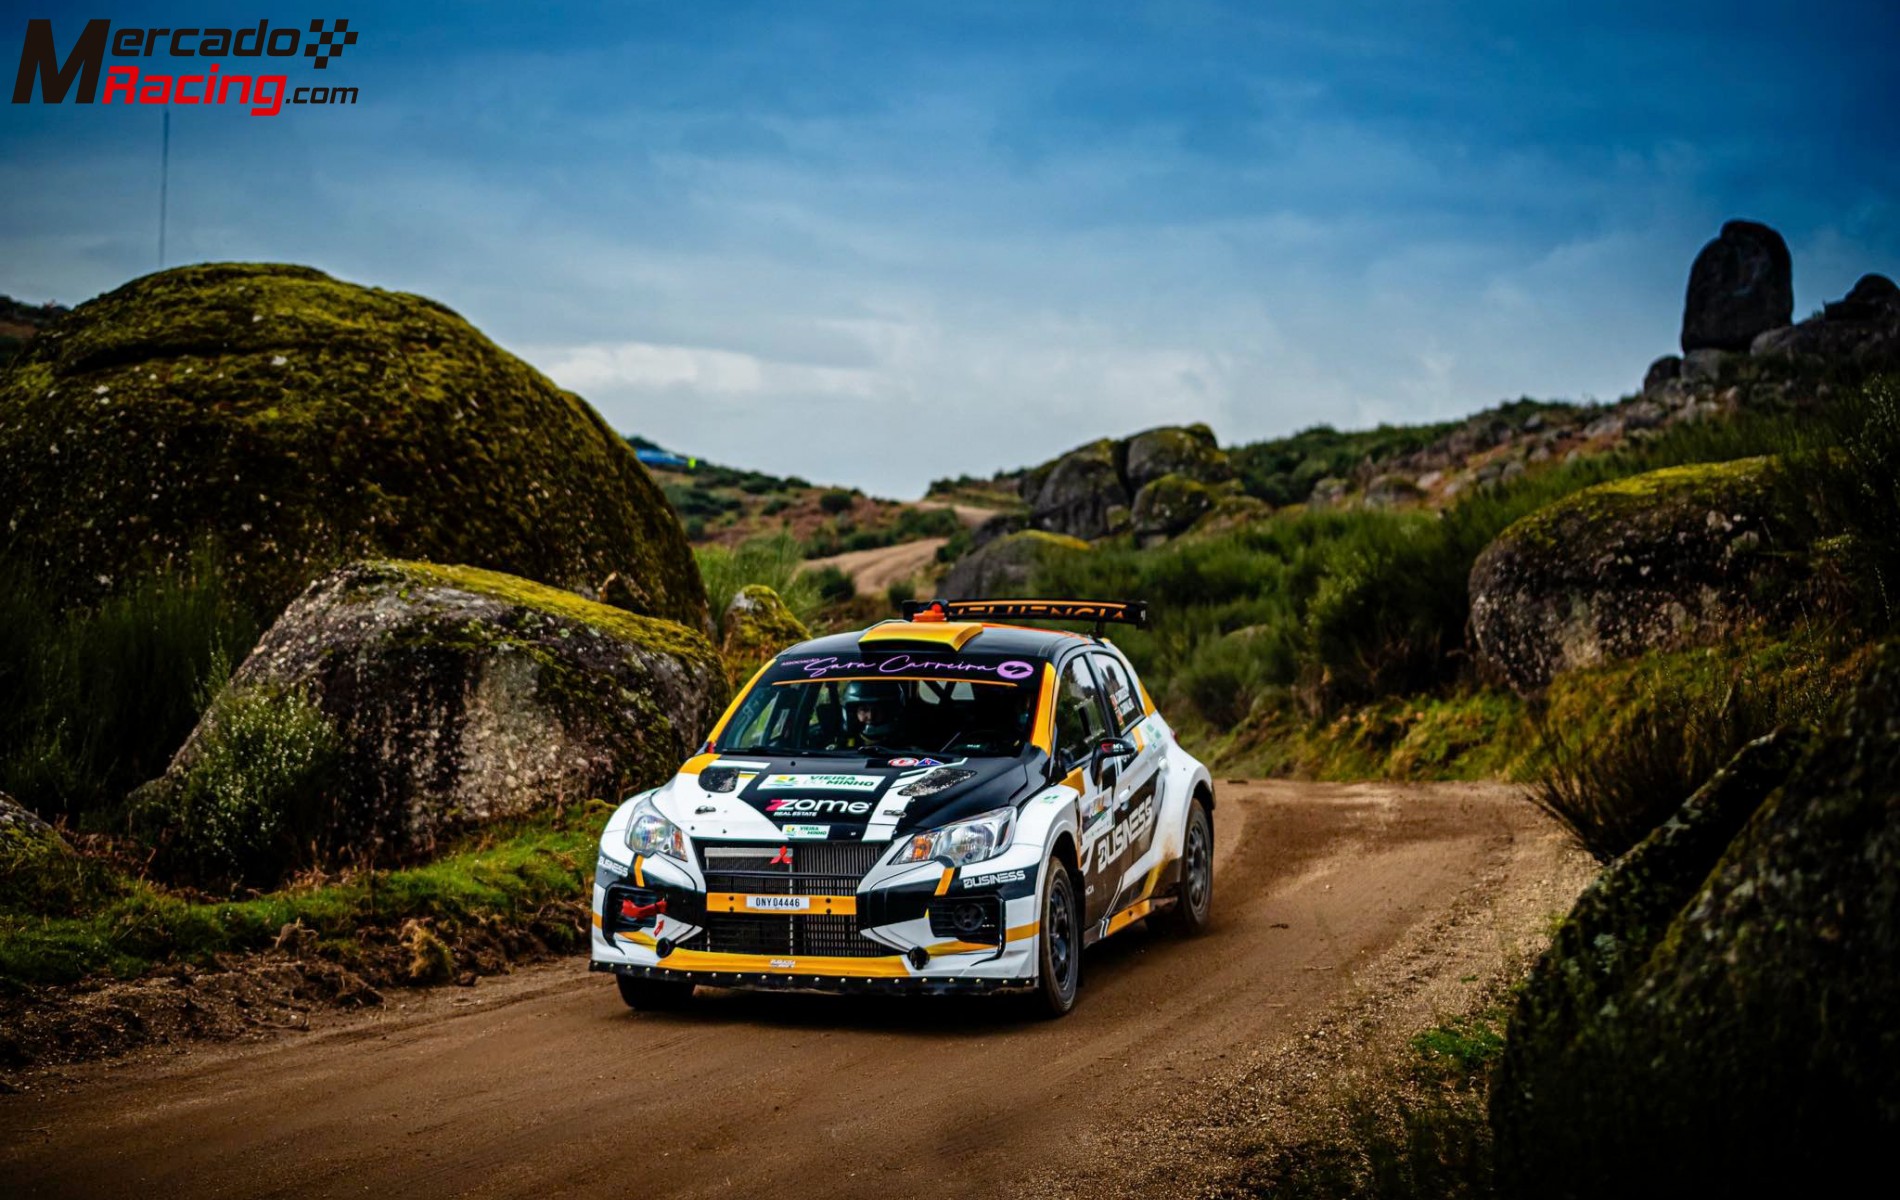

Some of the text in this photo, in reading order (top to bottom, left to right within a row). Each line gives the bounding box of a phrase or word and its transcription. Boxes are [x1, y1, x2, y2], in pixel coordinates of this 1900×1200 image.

[804, 655, 999, 678] Sara Carreira
[1098, 794, 1153, 875] BUSINESS
[963, 869, 1026, 889] BUSINESS
